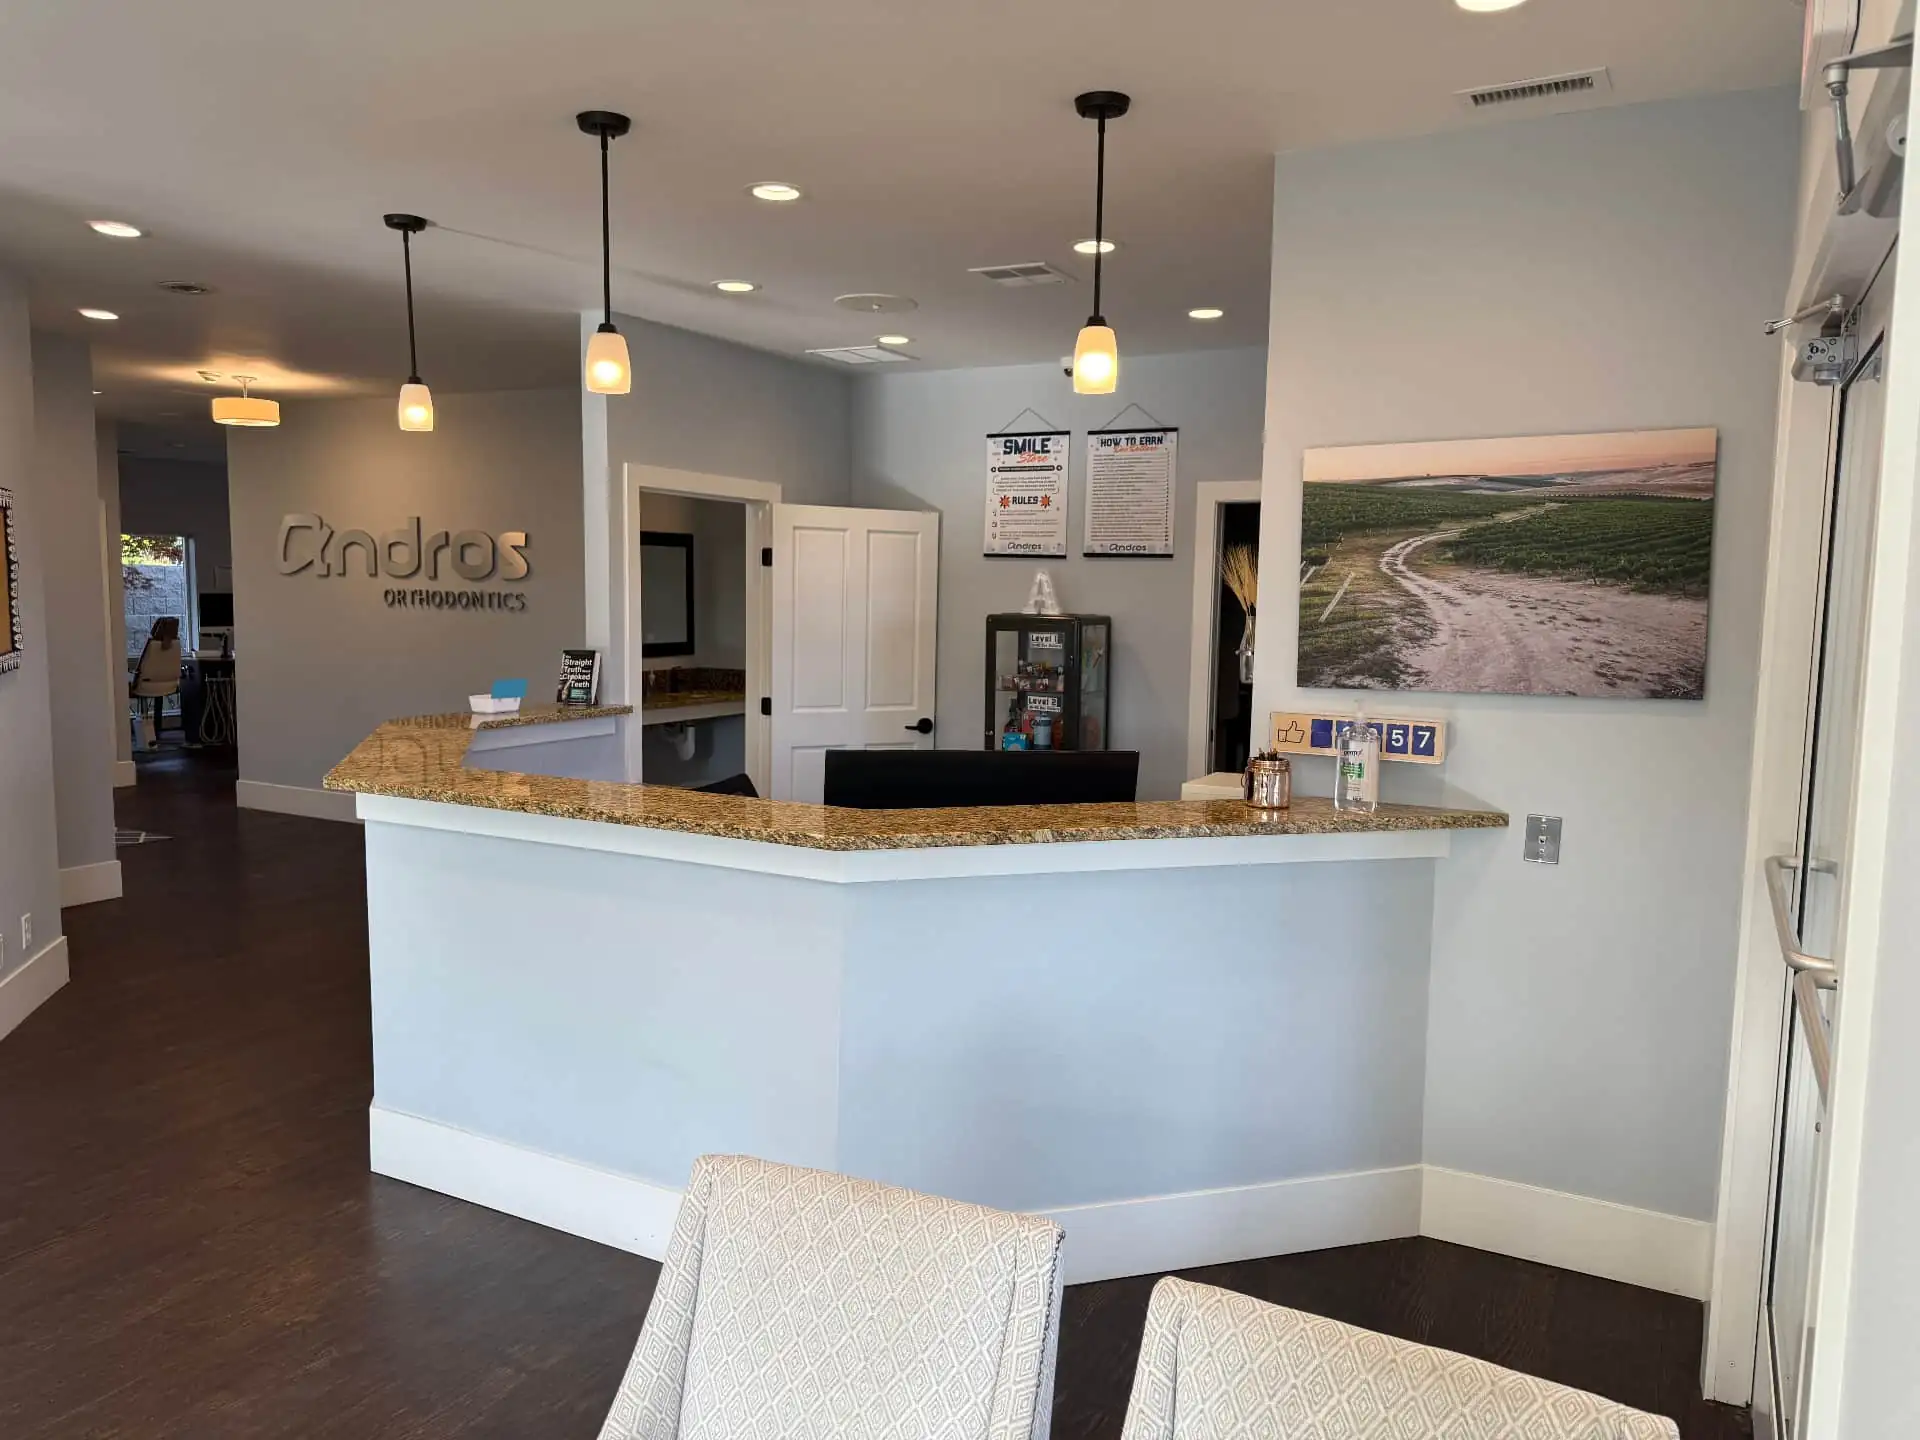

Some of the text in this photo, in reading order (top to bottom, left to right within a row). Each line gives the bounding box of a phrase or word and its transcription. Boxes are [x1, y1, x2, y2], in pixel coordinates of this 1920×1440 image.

[1101, 435, 1163, 447] HOW TO EARN
[1003, 437, 1051, 455] SMILE
[1012, 496, 1039, 504] RULES
[383, 588, 526, 611] ORTHODONTICS
[1031, 634, 1052, 642] Level
[564, 658, 593, 667] Straight
[1029, 697, 1049, 705] Level
